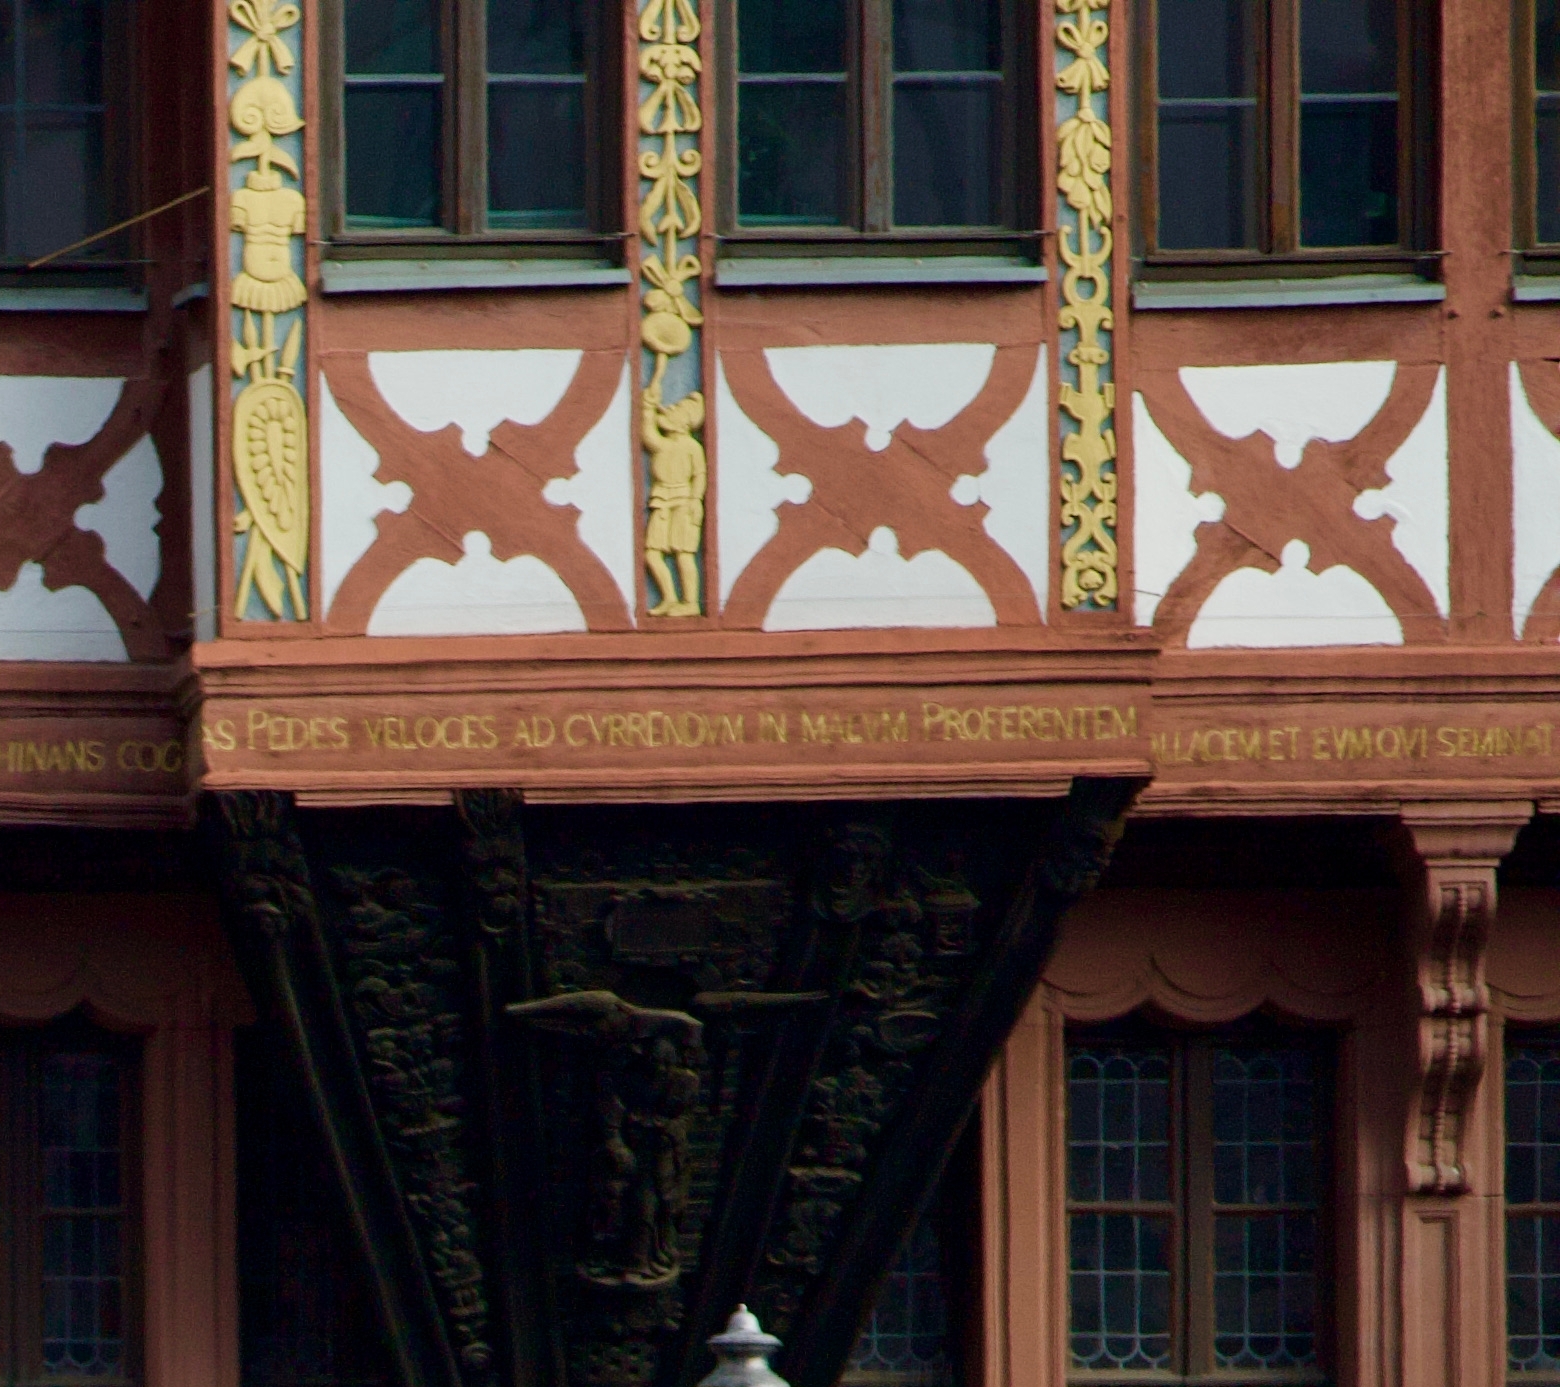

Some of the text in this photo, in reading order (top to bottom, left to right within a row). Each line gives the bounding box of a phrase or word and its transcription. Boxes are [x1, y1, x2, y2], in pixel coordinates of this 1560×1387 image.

[248, 708, 350, 751] PEDES
[362, 714, 501, 752] VELOCES
[513, 715, 556, 750] AD
[758, 710, 789, 744] IN
[922, 702, 1139, 743] PROFERENTEM
[1268, 726, 1302, 760] ET
